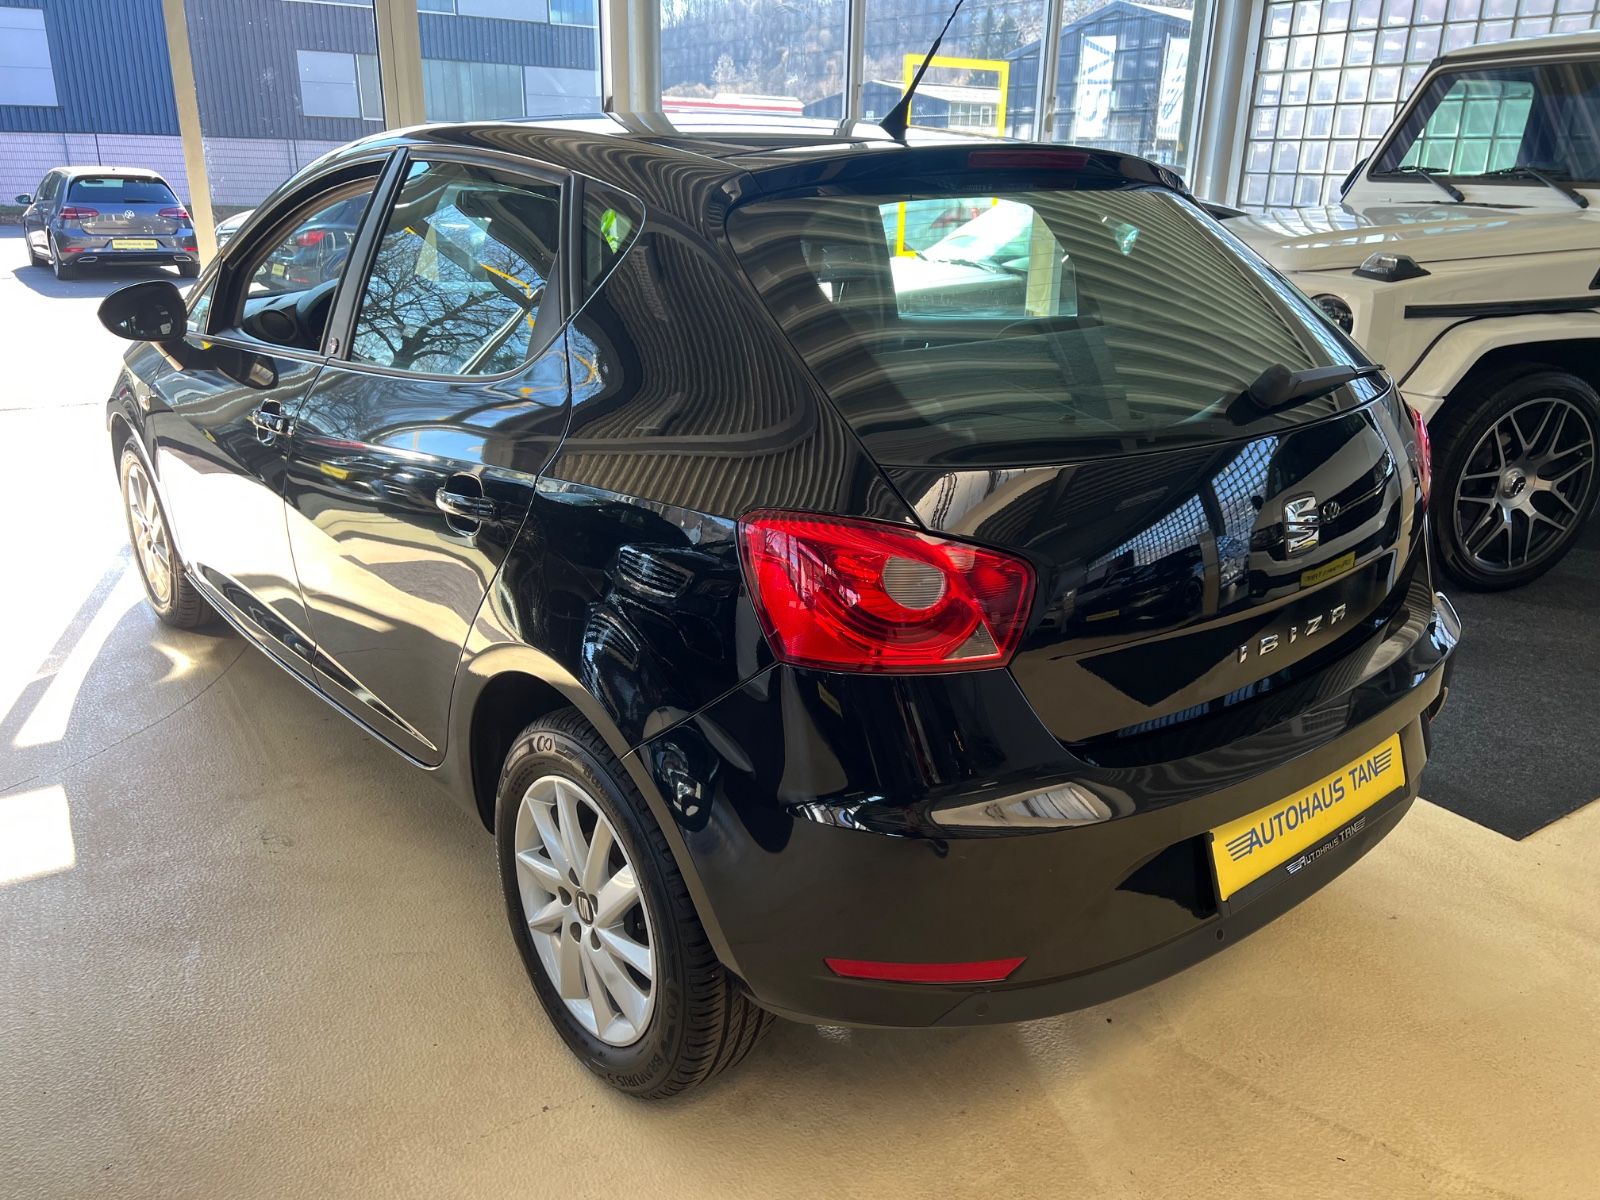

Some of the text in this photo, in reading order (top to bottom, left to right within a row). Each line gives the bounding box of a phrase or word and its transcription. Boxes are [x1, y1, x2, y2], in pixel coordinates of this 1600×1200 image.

[1239, 603, 1346, 663] IBIZA
[1248, 756, 1379, 854] AUTOHAUS TAN
